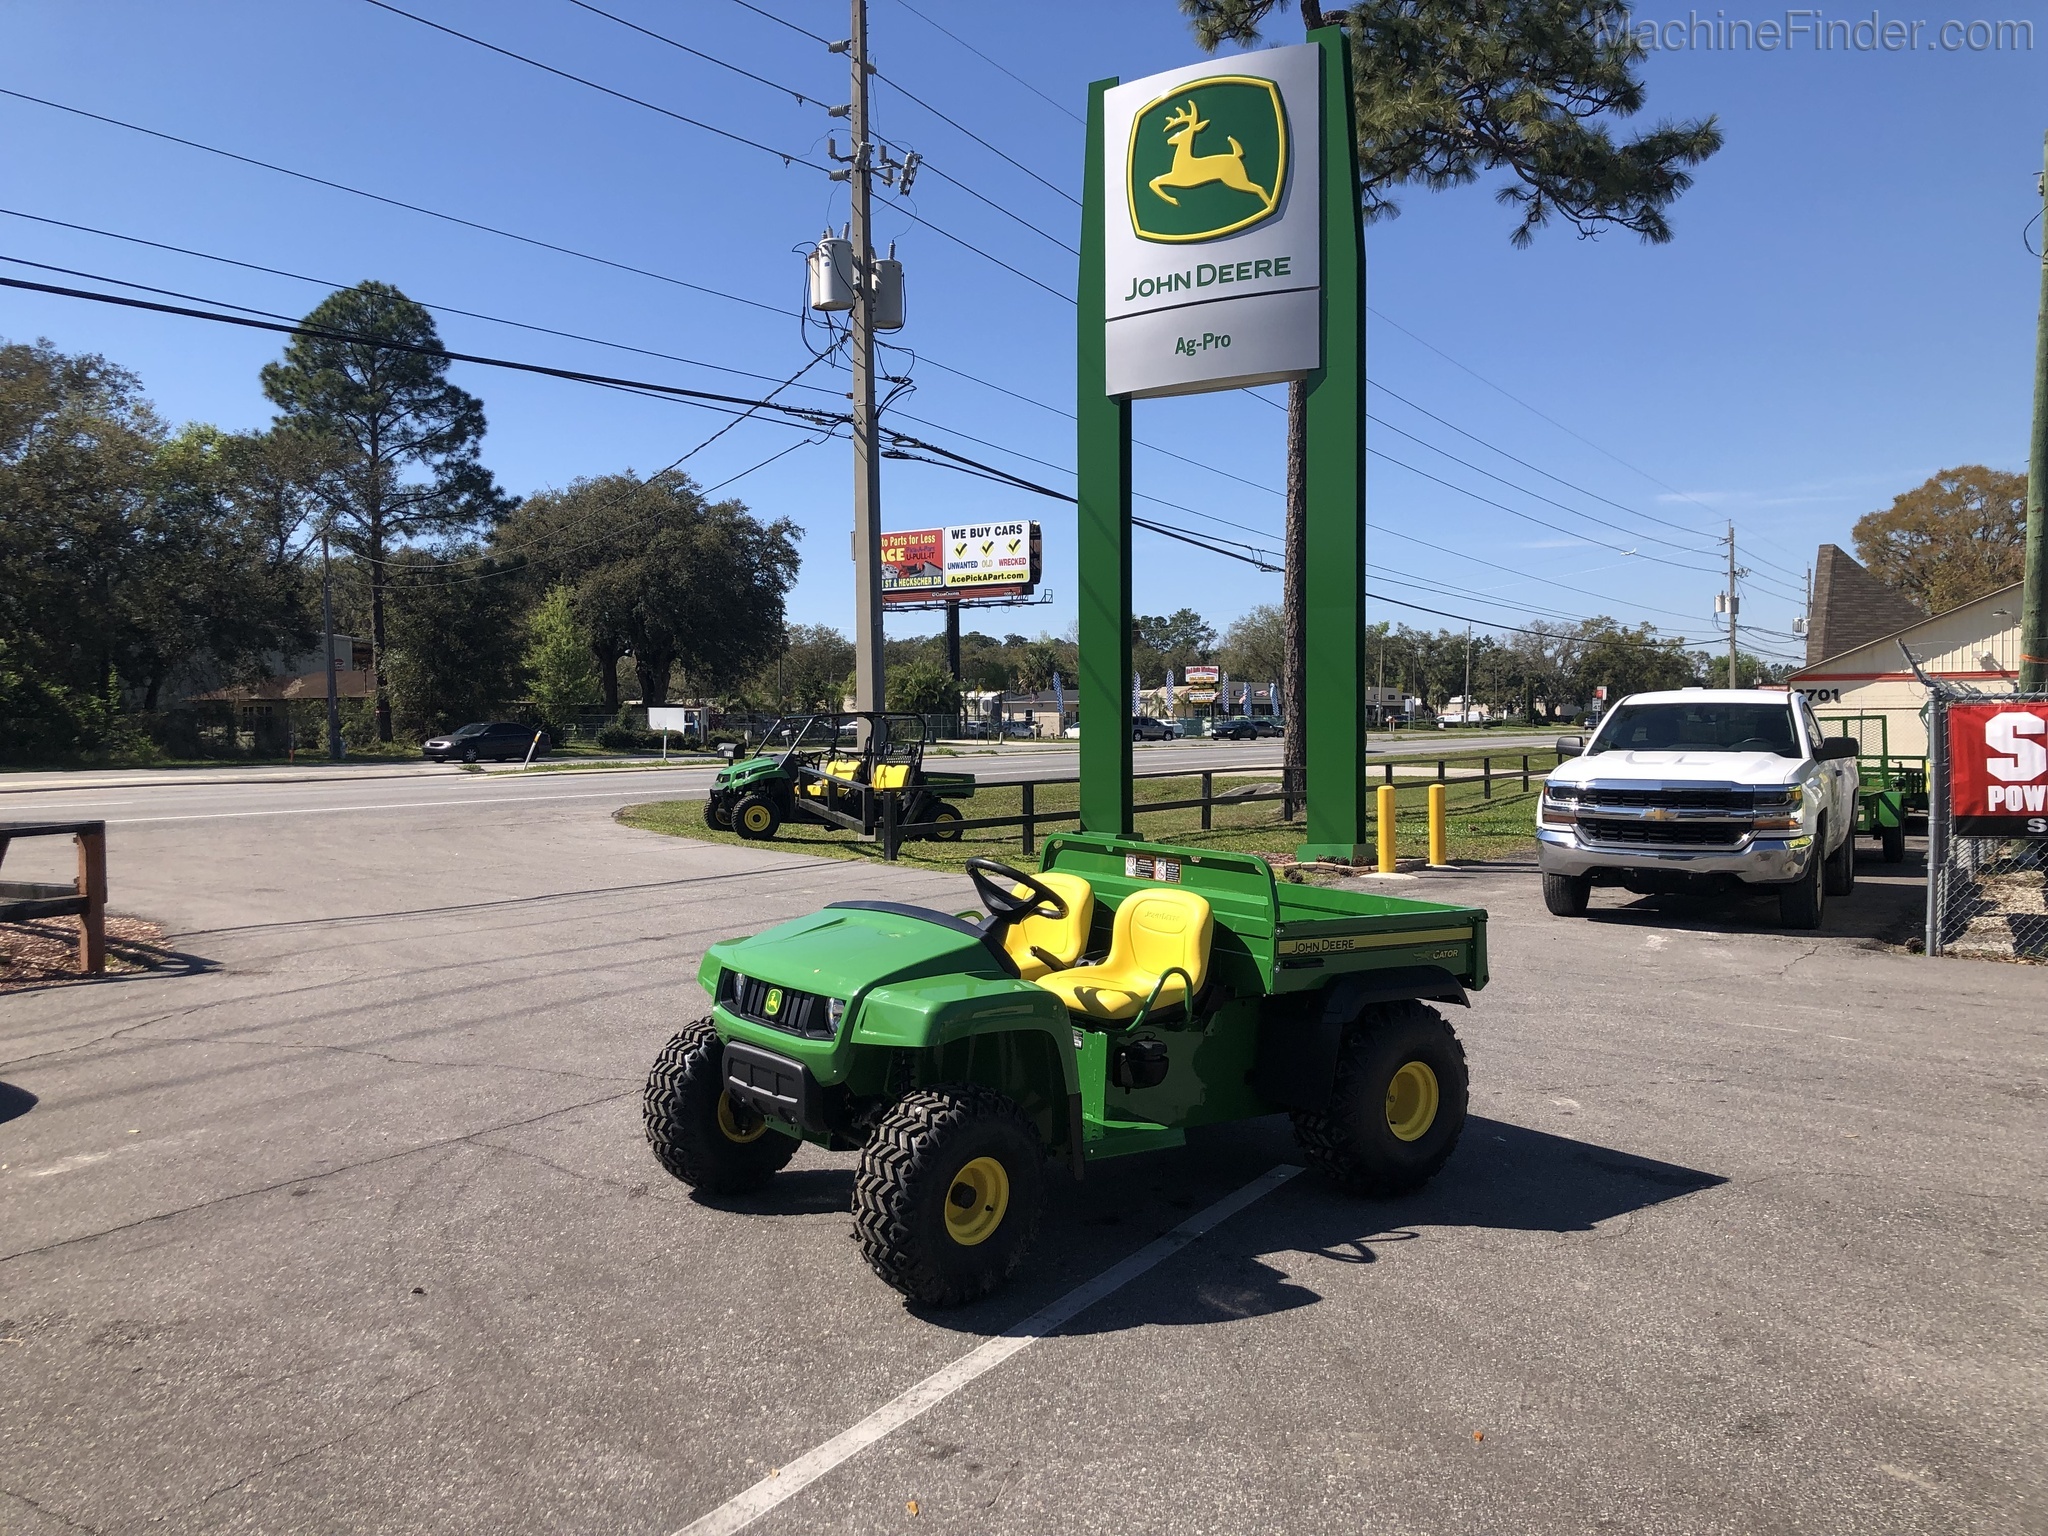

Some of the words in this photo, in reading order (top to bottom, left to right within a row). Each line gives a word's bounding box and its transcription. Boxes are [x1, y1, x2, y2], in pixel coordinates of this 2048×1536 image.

[1124, 270, 1191, 301] JOHN
[1196, 256, 1291, 288] DEERE
[1174, 332, 1231, 356] Ag-Pro
[951, 529, 967, 540] WE
[970, 527, 991, 538] BUY
[994, 524, 1023, 536] CARS
[890, 536, 907, 546] Parts
[909, 535, 918, 544] for
[920, 534, 936, 544] Less
[906, 552, 935, 561] U-PULL-IT
[947, 561, 978, 570] UNWANTED
[982, 560, 993, 568] OLD
[998, 558, 1026, 567] WRECKED
[898, 577, 932, 587] HECKSCHER
[933, 576, 942, 585] DR
[951, 573, 1024, 583] AcePickAPart.com
[1985, 712, 2048, 782] S
[1987, 785, 2048, 812] POW
[1291, 941, 1320, 954] JOHN
[1321, 939, 1355, 951] DEERE
[1432, 949, 1459, 960] GATOR
